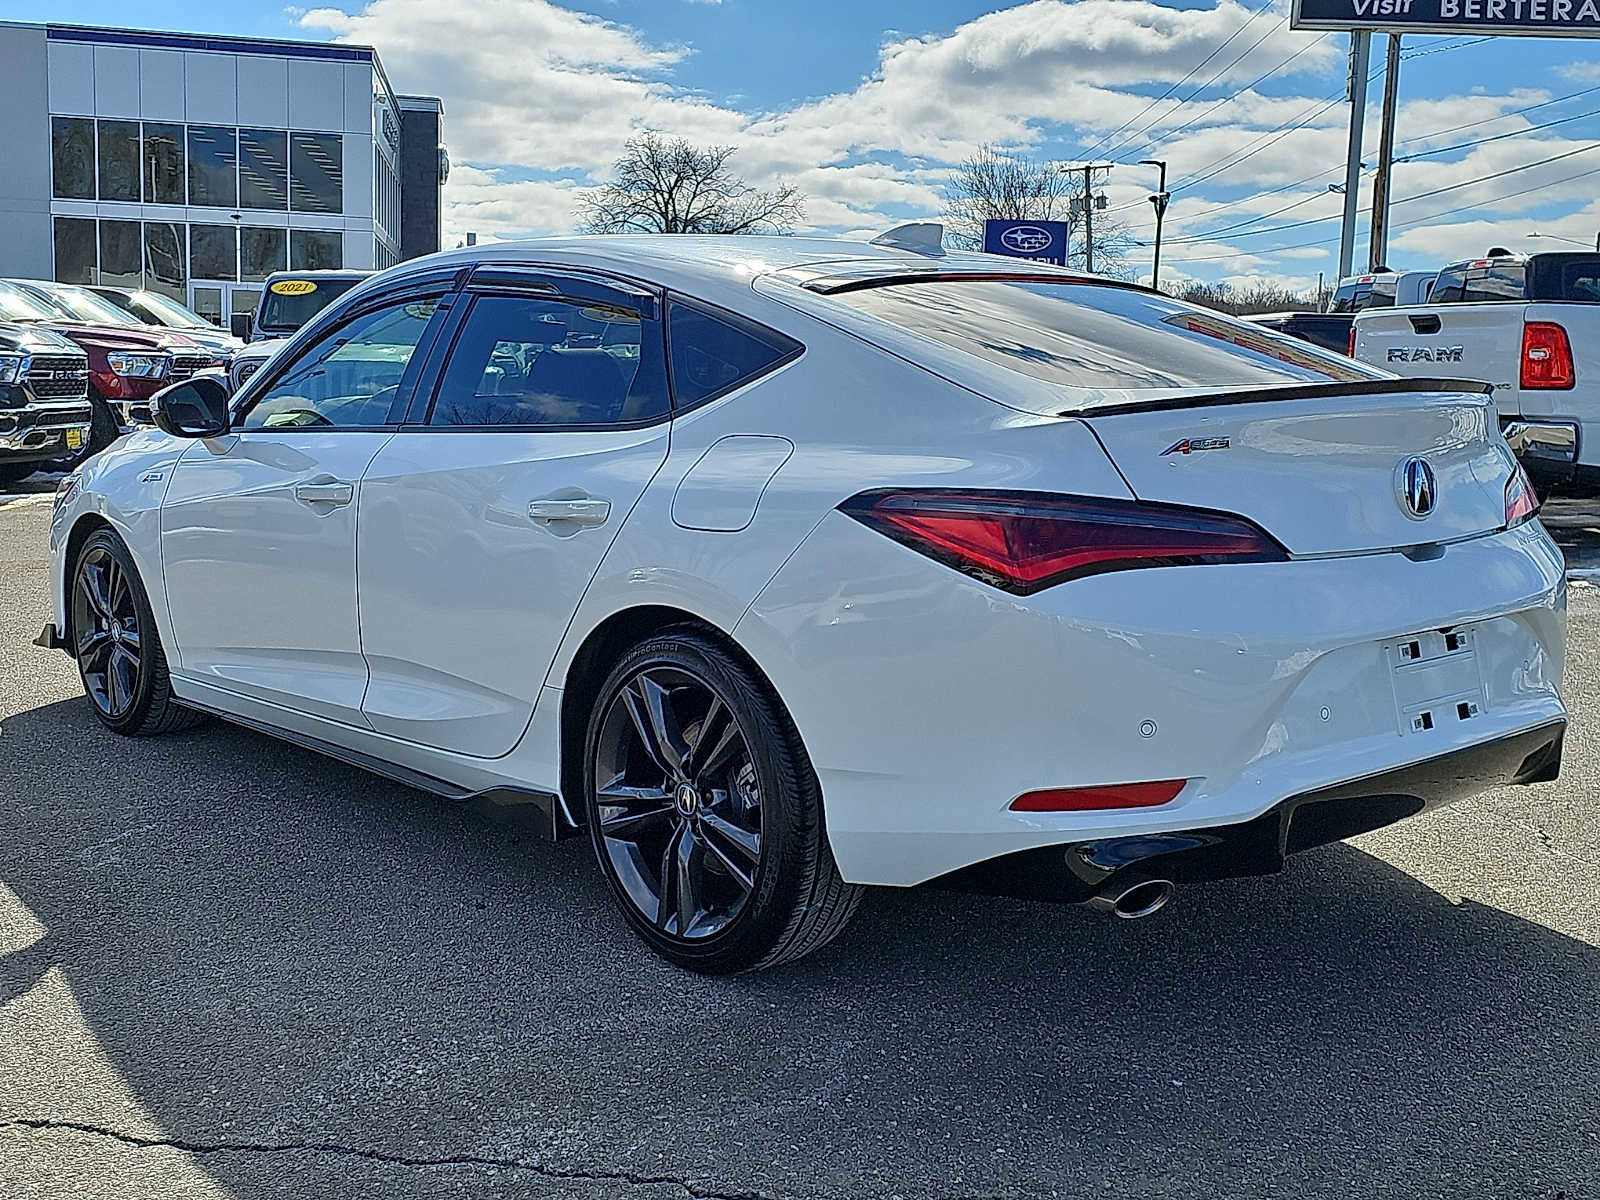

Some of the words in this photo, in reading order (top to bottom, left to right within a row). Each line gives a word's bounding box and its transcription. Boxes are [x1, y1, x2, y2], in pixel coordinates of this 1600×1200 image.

[1352, 0, 1414, 16] Visit
[279, 283, 310, 292] 2021
[1386, 345, 1464, 362] RAM
